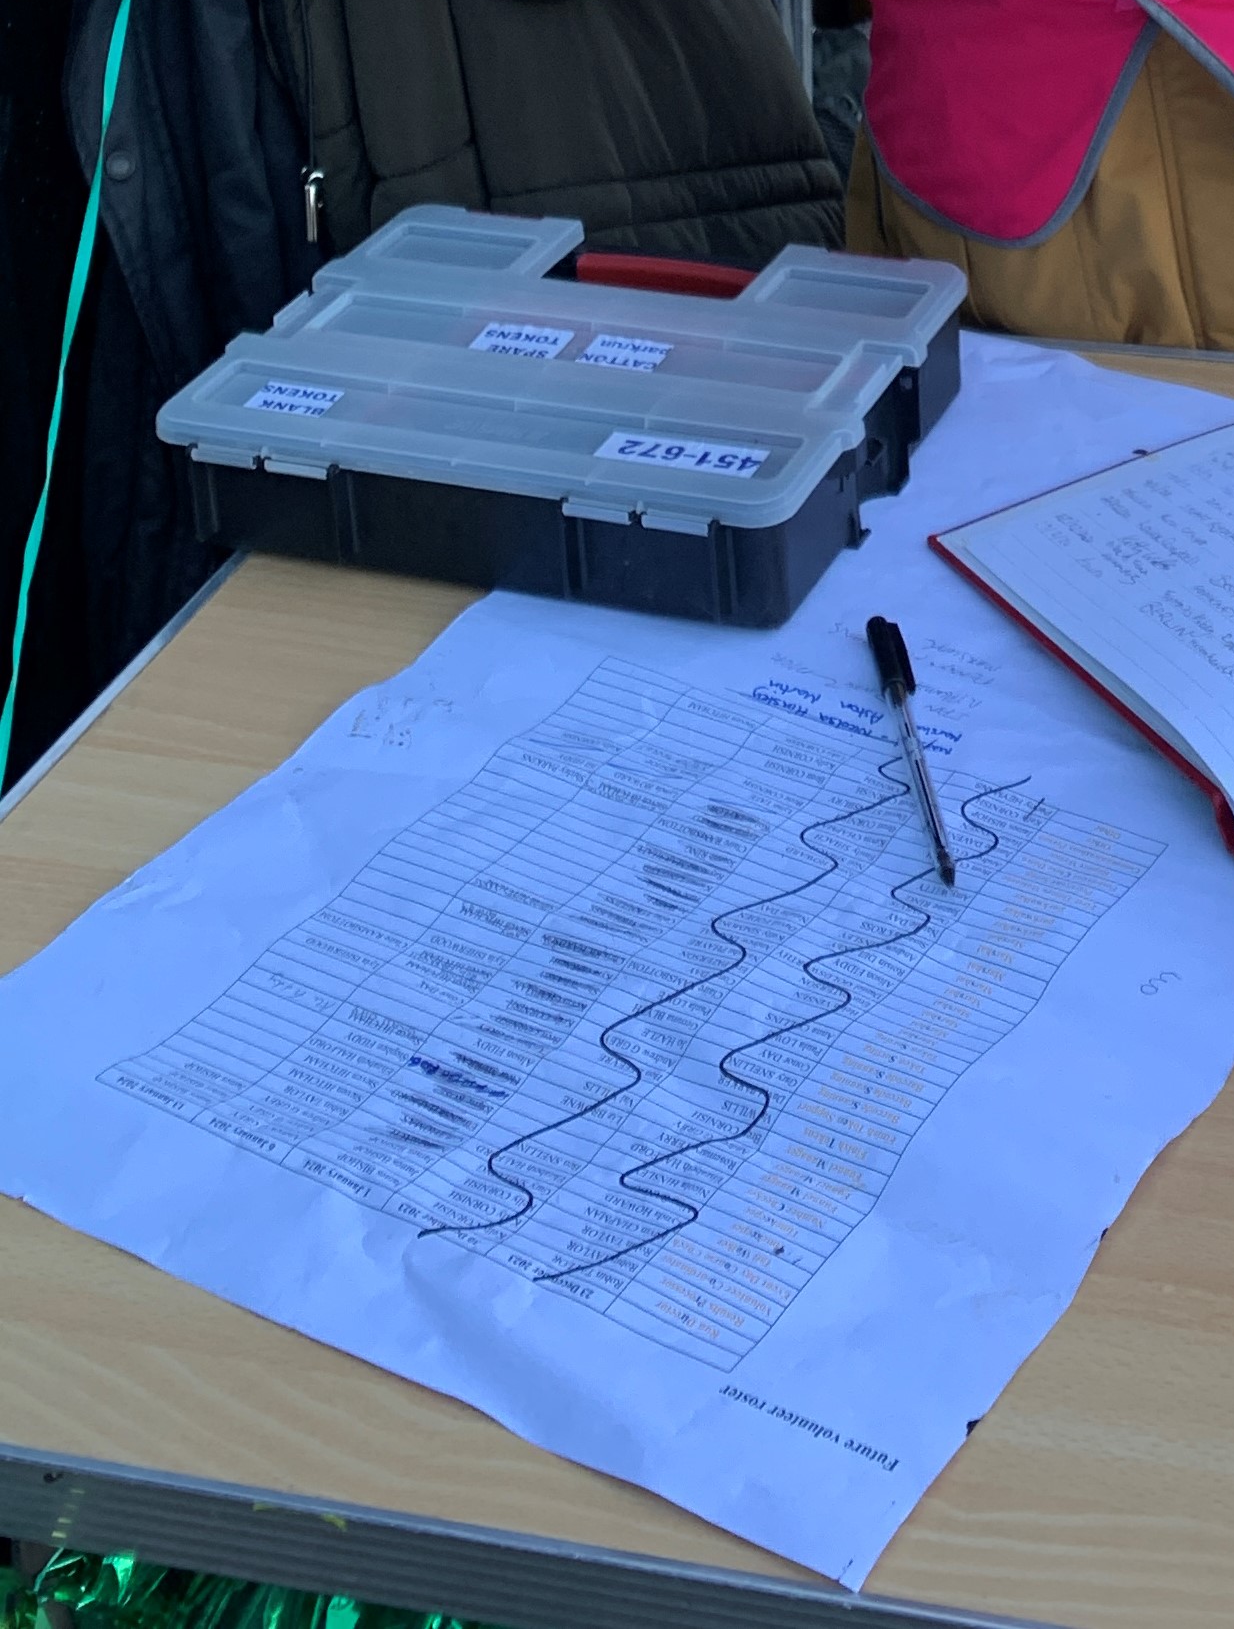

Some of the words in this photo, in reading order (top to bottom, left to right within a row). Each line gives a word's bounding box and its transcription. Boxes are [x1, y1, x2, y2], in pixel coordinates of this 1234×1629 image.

[485, 328, 560, 345] TOKENS
[599, 340, 671, 357] parkrun
[580, 352, 658, 371] CATTON
[261, 384, 338, 403] TOKENS
[617, 439, 762, 472] 451-672
[768, 680, 821, 705] Martin
[839, 701, 885, 726] Aston
[916, 725, 963, 743] Marsha
[758, 1048, 782, 1063] DAY
[136, 1079, 173, 1107] January
[721, 1100, 757, 1121] WILLIS
[231, 1122, 268, 1149] January
[326, 1166, 363, 1195] January
[719, 1385, 767, 1412] roster
[767, 1404, 840, 1446] volunteer
[843, 1438, 899, 1472] Future
